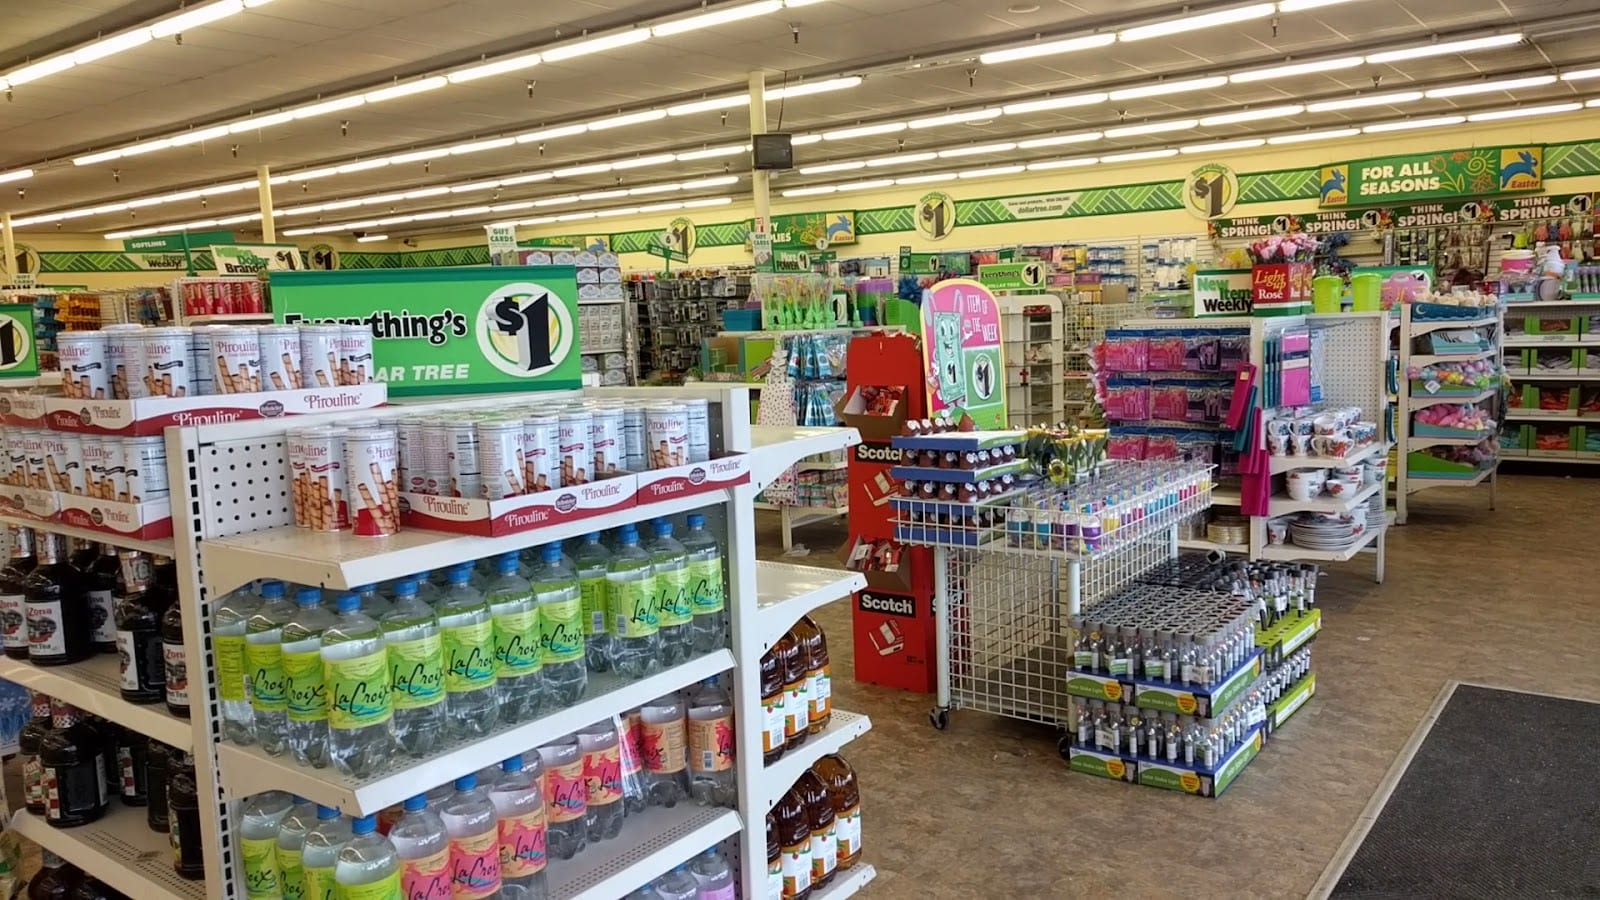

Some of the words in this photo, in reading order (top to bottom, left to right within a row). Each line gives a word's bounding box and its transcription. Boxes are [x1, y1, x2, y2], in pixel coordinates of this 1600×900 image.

[1361, 165, 1394, 181] FOR
[1399, 161, 1433, 177] ALL
[1360, 177, 1441, 196] SEASONS
[1511, 179, 1540, 190] Easter
[1194, 175, 1224, 217] $1
[1326, 195, 1347, 204] Easter
[1514, 197, 1550, 207] THINK
[1017, 204, 1063, 214] dollartree.com
[1315, 211, 1347, 221] THINK
[1410, 203, 1444, 214] THINK
[1499, 203, 1567, 221] SPRING!
[920, 201, 946, 239] $1
[1231, 218, 1259, 226] THINK
[1305, 220, 1360, 233] SPRING!
[1397, 212, 1459, 228] SPRING!
[490, 235, 515, 243] CARDS
[1221, 225, 1271, 237] SPRING!
[980, 270, 1021, 279] Everything's
[1025, 264, 1039, 285] $1
[1254, 269, 1286, 285] Light
[1197, 277, 1230, 292] New
[1271, 279, 1287, 290] up
[1258, 288, 1283, 300] Rose
[966, 294, 982, 313] ITEM
[981, 299, 989, 315] OF
[488, 292, 556, 371] $1
[971, 317, 982, 333] THE
[981, 323, 998, 342] WEEK
[412, 364, 470, 382] TREE
[976, 362, 990, 397] $1
[303, 392, 362, 410] Pirouline
[172, 410, 241, 427] Pirouline
[708, 460, 741, 475] Pirouline
[581, 483, 622, 501] Pirouline
[650, 480, 685, 496] Pirouline
[423, 495, 471, 516] Pirouline
[504, 509, 550, 528] Pirouline
[861, 594, 913, 615] Scotch
[332, 680, 390, 714] LaCroix
